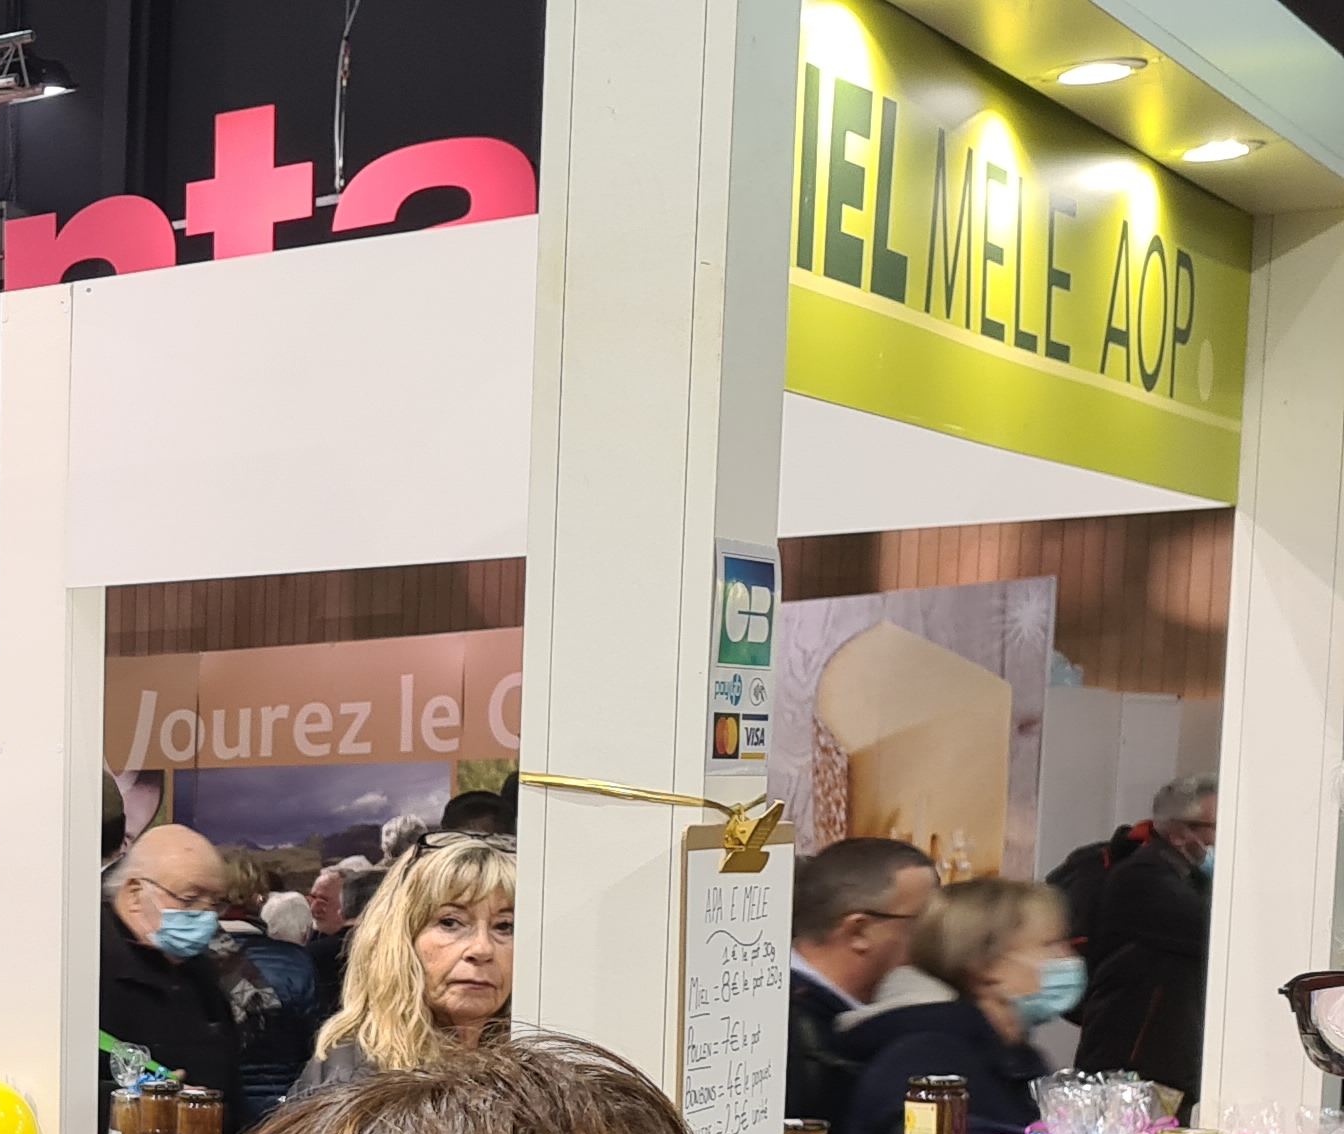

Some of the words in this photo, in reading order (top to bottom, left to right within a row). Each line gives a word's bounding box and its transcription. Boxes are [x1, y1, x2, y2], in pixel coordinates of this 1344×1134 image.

[797, 63, 908, 304] IEL
[924, 127, 1078, 363] MELE
[1100, 220, 1195, 398] AOP
[400, 674, 460, 753] le
[745, 727, 766, 747] VISA
[742, 886, 770, 922] MELE
